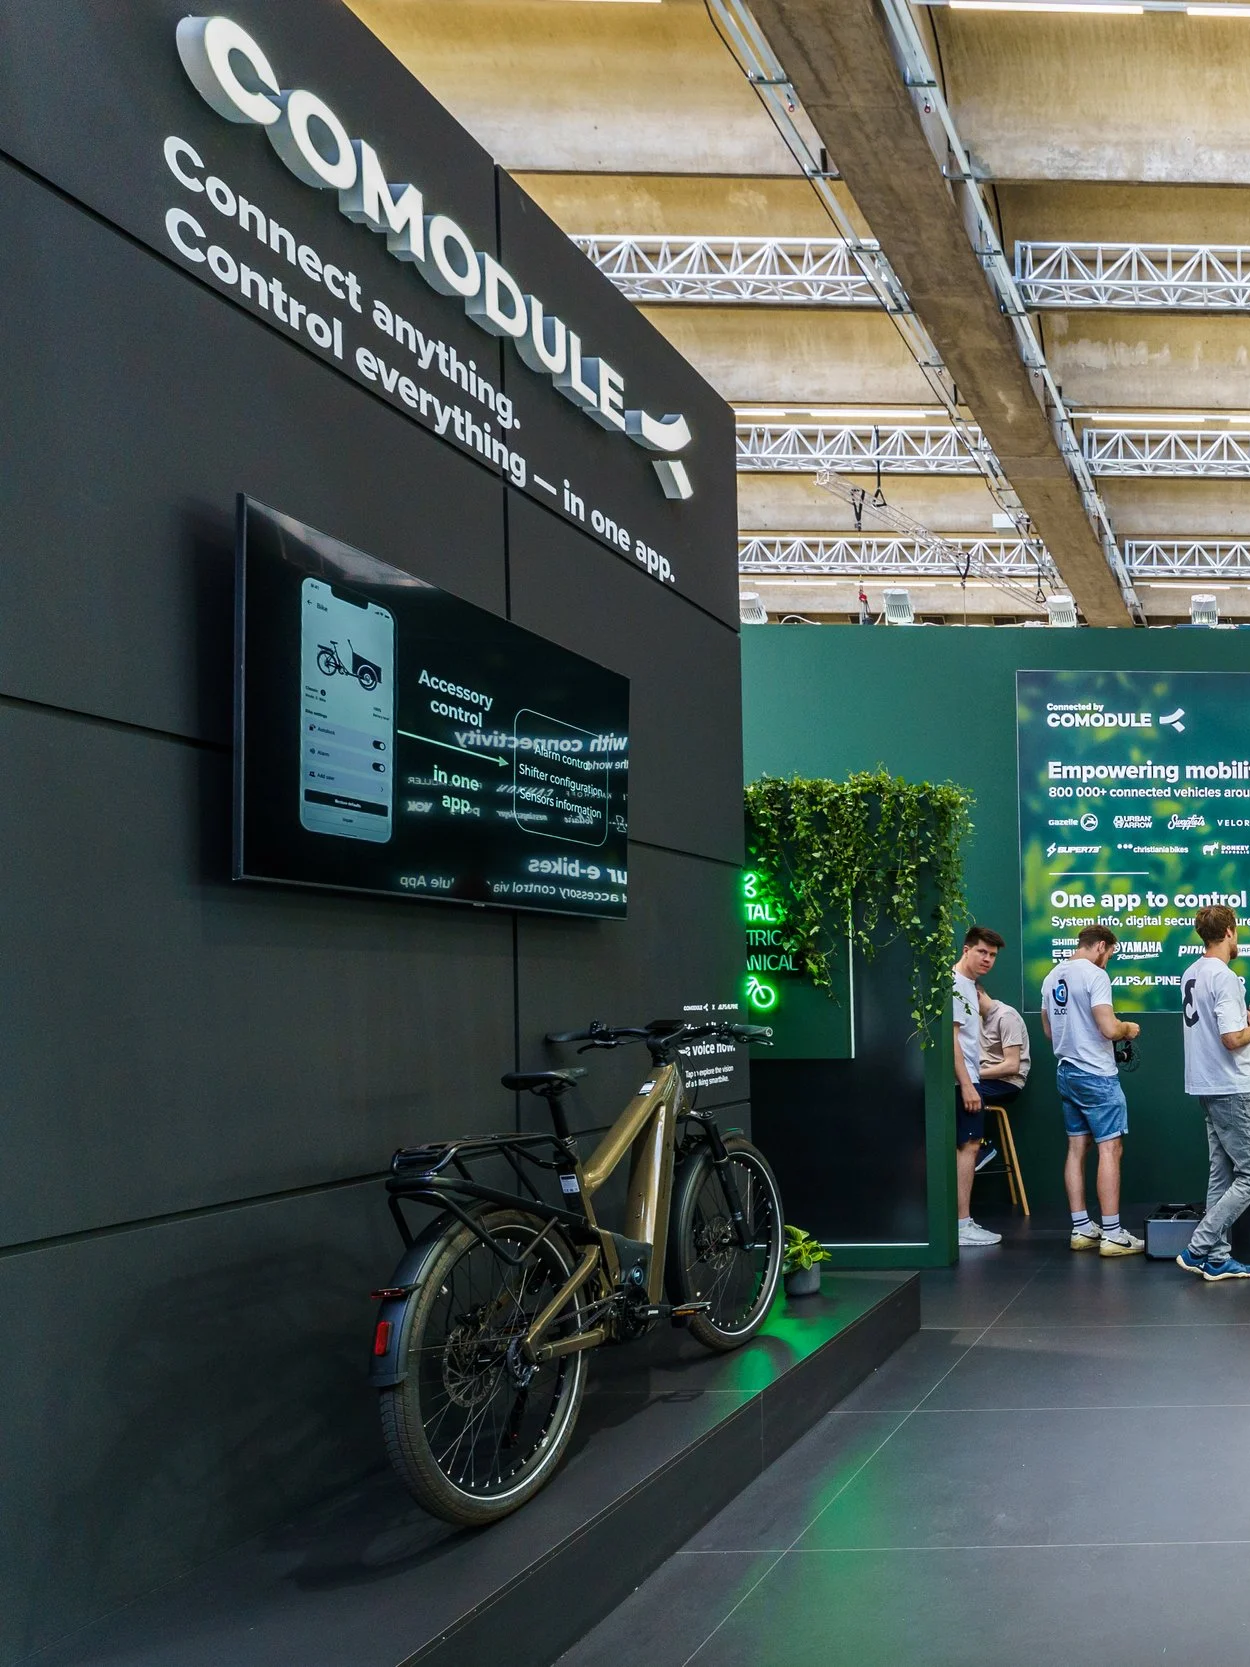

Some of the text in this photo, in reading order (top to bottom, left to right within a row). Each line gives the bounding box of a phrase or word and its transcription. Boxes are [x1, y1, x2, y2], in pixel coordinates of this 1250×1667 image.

[177, 15, 625, 430] COMODULE
[164, 136, 521, 429] Connect anything.
[165, 208, 342, 359] Control
[356, 349, 526, 487] everything
[563, 481, 585, 520] in
[591, 509, 630, 552] one
[635, 539, 676, 583] app.
[418, 669, 493, 712] Accessory
[430, 700, 483, 728] control
[1047, 703, 1104, 712] Connected by
[1046, 713, 1152, 727] COMODULE
[534, 744, 560, 762] Alarm
[433, 764, 448, 782] in
[451, 775, 479, 792] one
[519, 763, 548, 782] Shifter
[550, 773, 603, 797] configuration
[1048, 761, 1179, 783] Empowering
[1049, 787, 1073, 798] 800
[1076, 787, 1107, 798] 000+
[1110, 787, 1171, 798] connected
[1173, 787, 1221, 798] vehicles
[442, 794, 471, 813] app
[520, 788, 602, 820] Sensors information
[1057, 846, 1101, 854] SUPER73
[1133, 845, 1189, 854] christiania bikes
[1051, 890, 1096, 908] One
[1100, 893, 1142, 912] app
[1147, 891, 1168, 908] to
[1174, 890, 1247, 908] control
[1051, 915, 1094, 928] System
[1097, 915, 1123, 928] info,
[1126, 915, 1162, 929] digital
[1120, 941, 1163, 953] YAMAHA
[692, 1041, 715, 1056] voice
[685, 1070, 694, 1079] Tap
